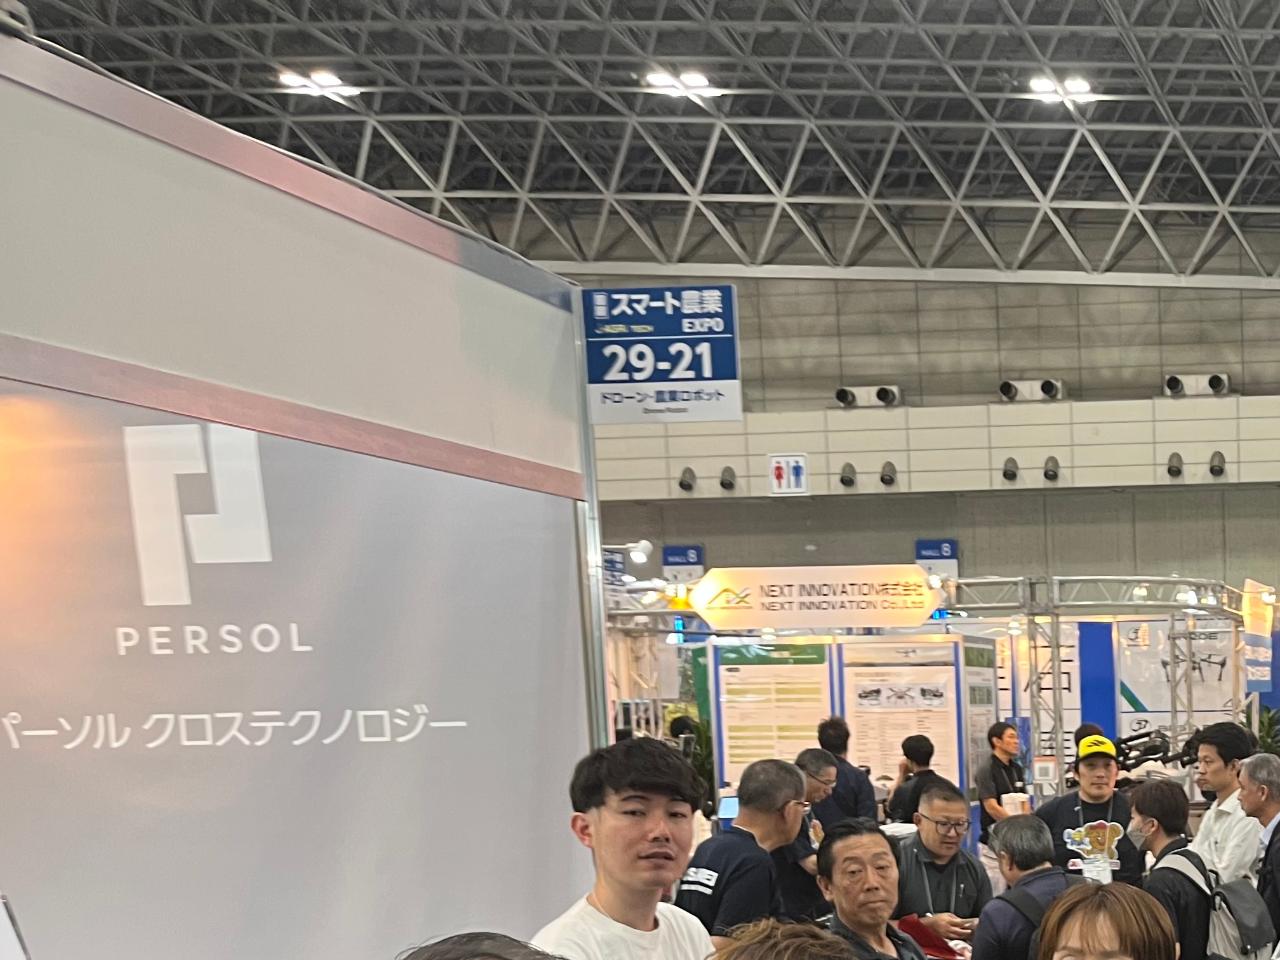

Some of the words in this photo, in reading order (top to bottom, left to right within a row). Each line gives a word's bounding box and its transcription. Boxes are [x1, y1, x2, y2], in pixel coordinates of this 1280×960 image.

[681, 318, 725, 333] EXPO
[602, 342, 713, 381] 29-21
[687, 549, 698, 562] 8
[941, 543, 952, 556] 8
[760, 584, 794, 599] NEXT
[761, 601, 794, 611] NEXT
[799, 600, 878, 610] INNOVATION
[116, 622, 314, 656] PERSOL
[142, 703, 468, 750] クロステクノロジー
